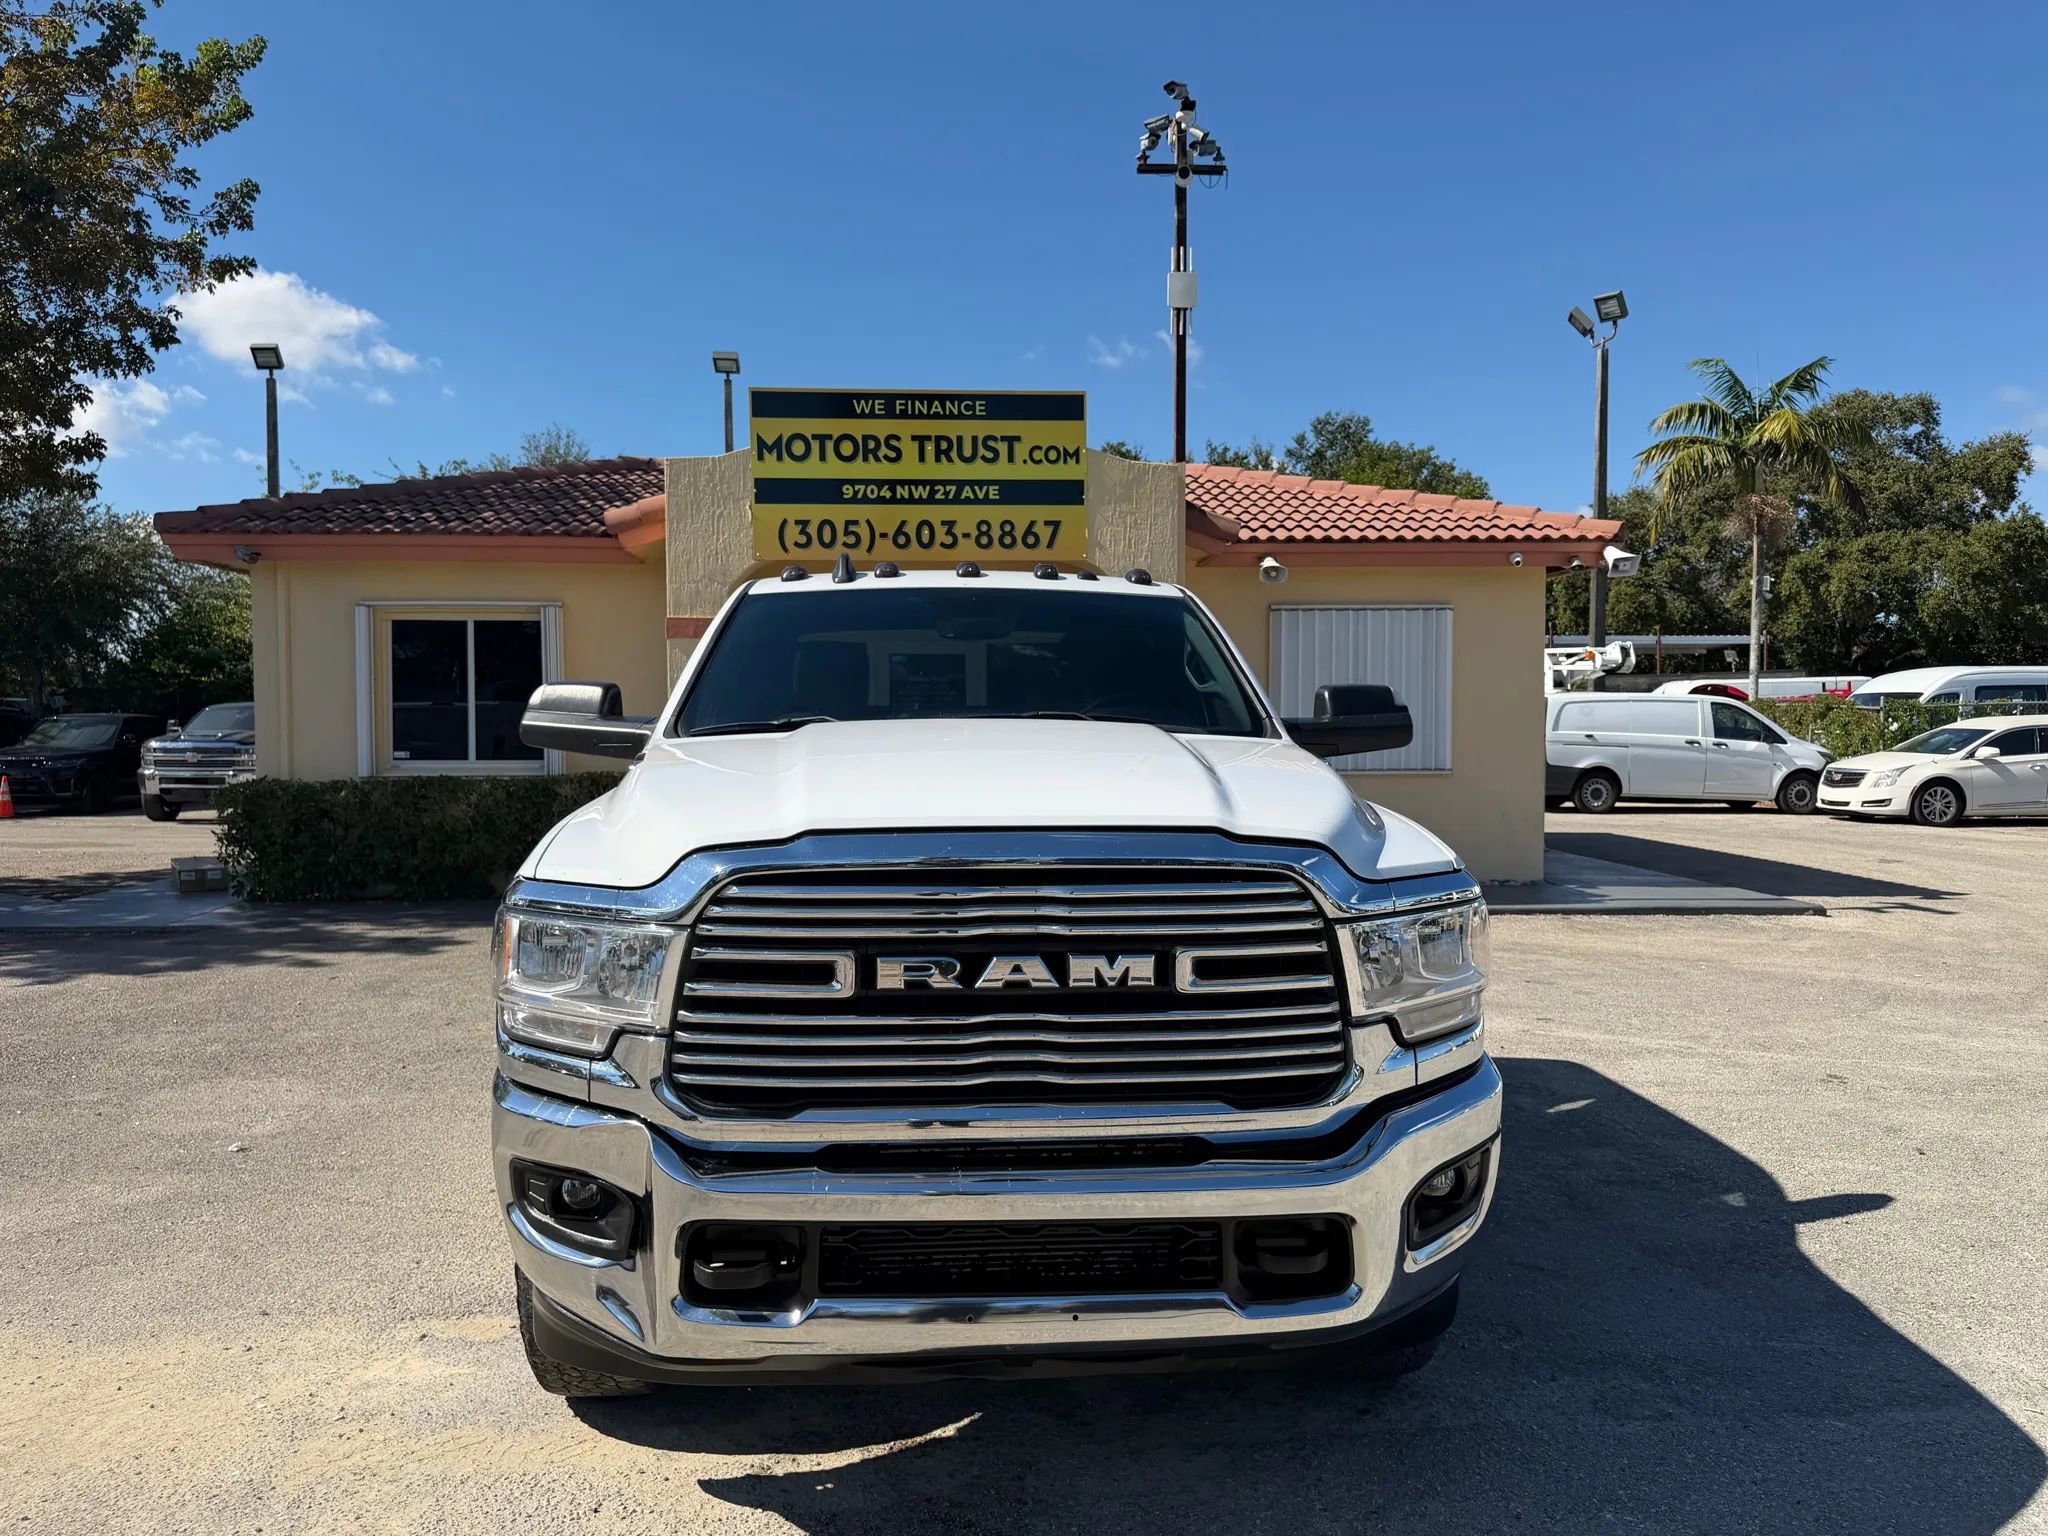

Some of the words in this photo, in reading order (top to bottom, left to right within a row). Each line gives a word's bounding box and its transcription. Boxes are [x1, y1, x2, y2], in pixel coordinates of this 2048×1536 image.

[853, 399, 886, 415] WE
[895, 400, 987, 416] FINANCE
[756, 432, 904, 464] MOTORS
[842, 485, 893, 499] 9704
[896, 485, 930, 499] NW
[934, 485, 957, 499] 27
[960, 485, 1000, 500] AVE
[777, 518, 1063, 555] (305)-603-8867
[876, 953, 1155, 990] RAM
